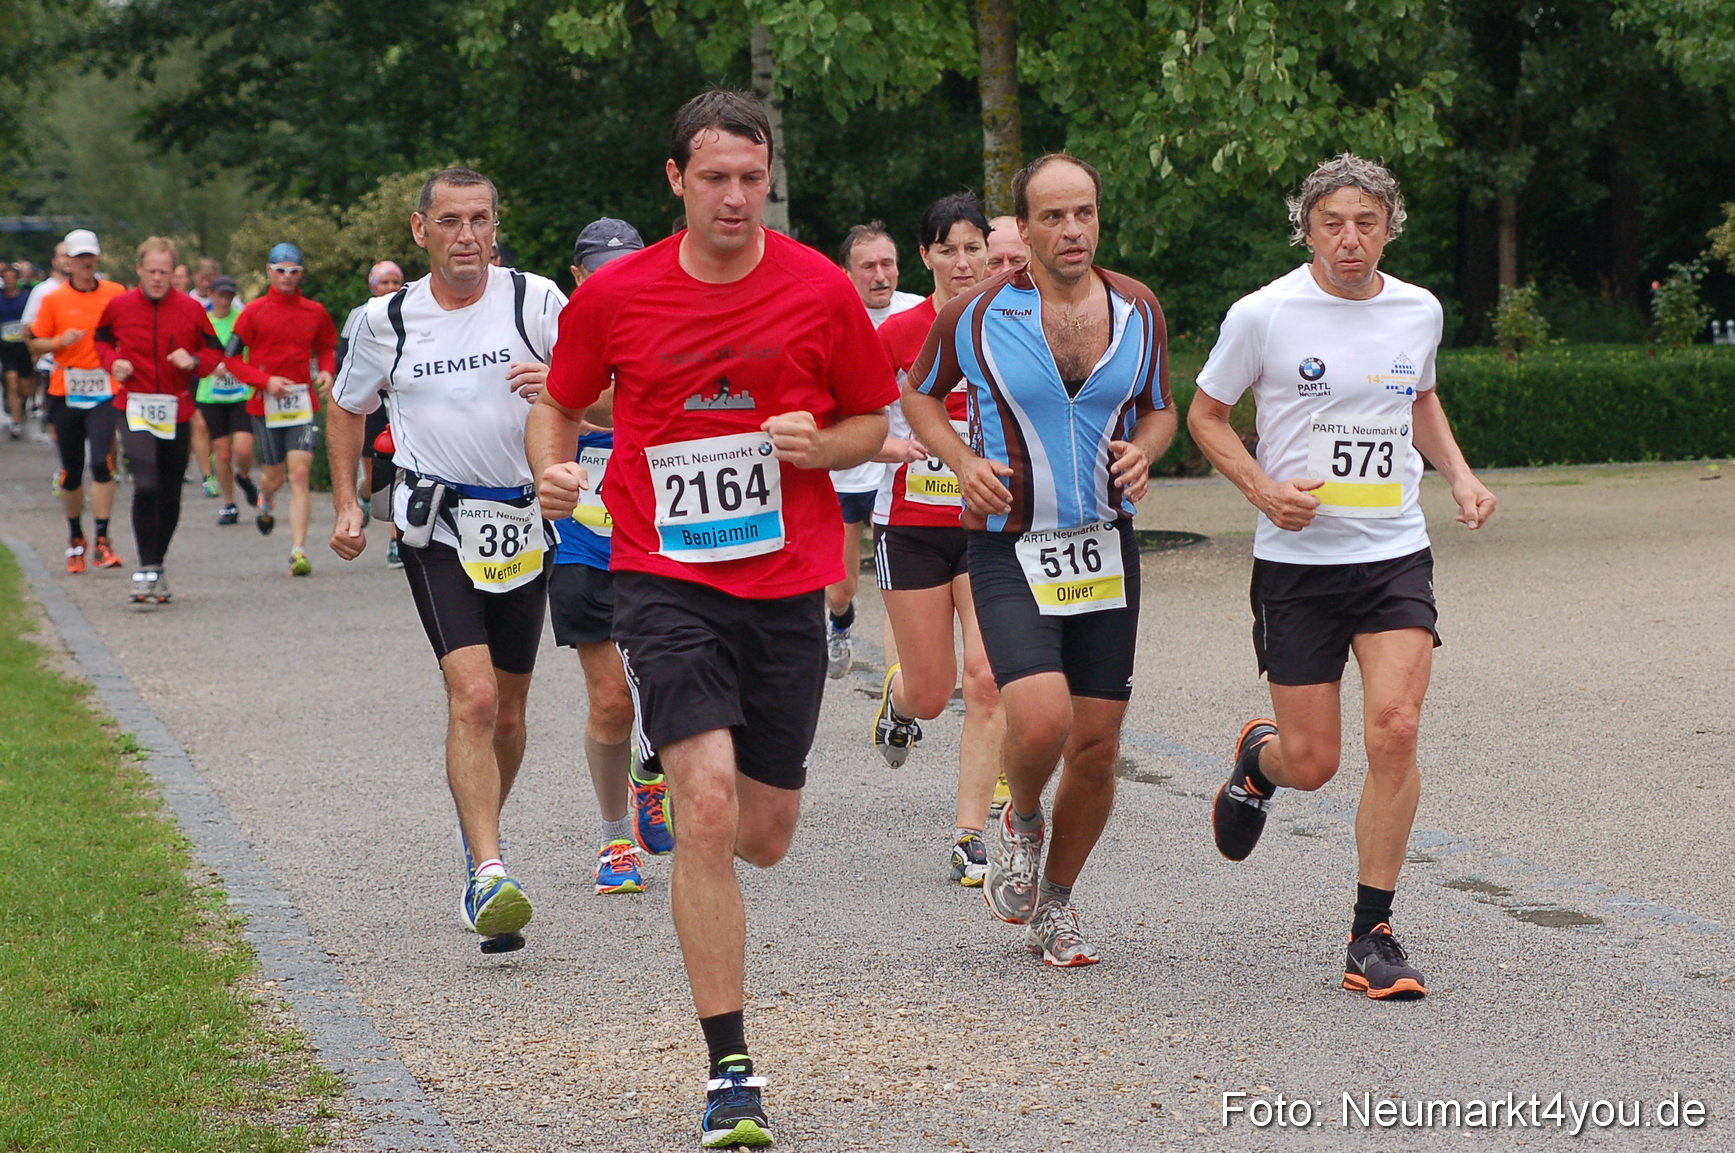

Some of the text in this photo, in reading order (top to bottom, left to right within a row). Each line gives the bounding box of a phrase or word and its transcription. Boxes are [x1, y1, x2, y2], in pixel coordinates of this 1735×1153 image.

[413, 348, 511, 378] SIEMENS
[1298, 383, 1331, 392] PARTL
[141, 404, 167, 421] 186
[1313, 424, 1397, 436] PARTL Neumarkt
[581, 456, 609, 466] PART
[651, 447, 754, 469] PARTL Neumarkt
[1332, 441, 1394, 478] 573
[666, 463, 770, 518] 2164
[460, 509, 493, 519] PARTL
[681, 522, 759, 548] Benjamin
[1040, 538, 1102, 578] 516
[484, 562, 522, 580] Werner
[1057, 586, 1094, 602] Oliver
